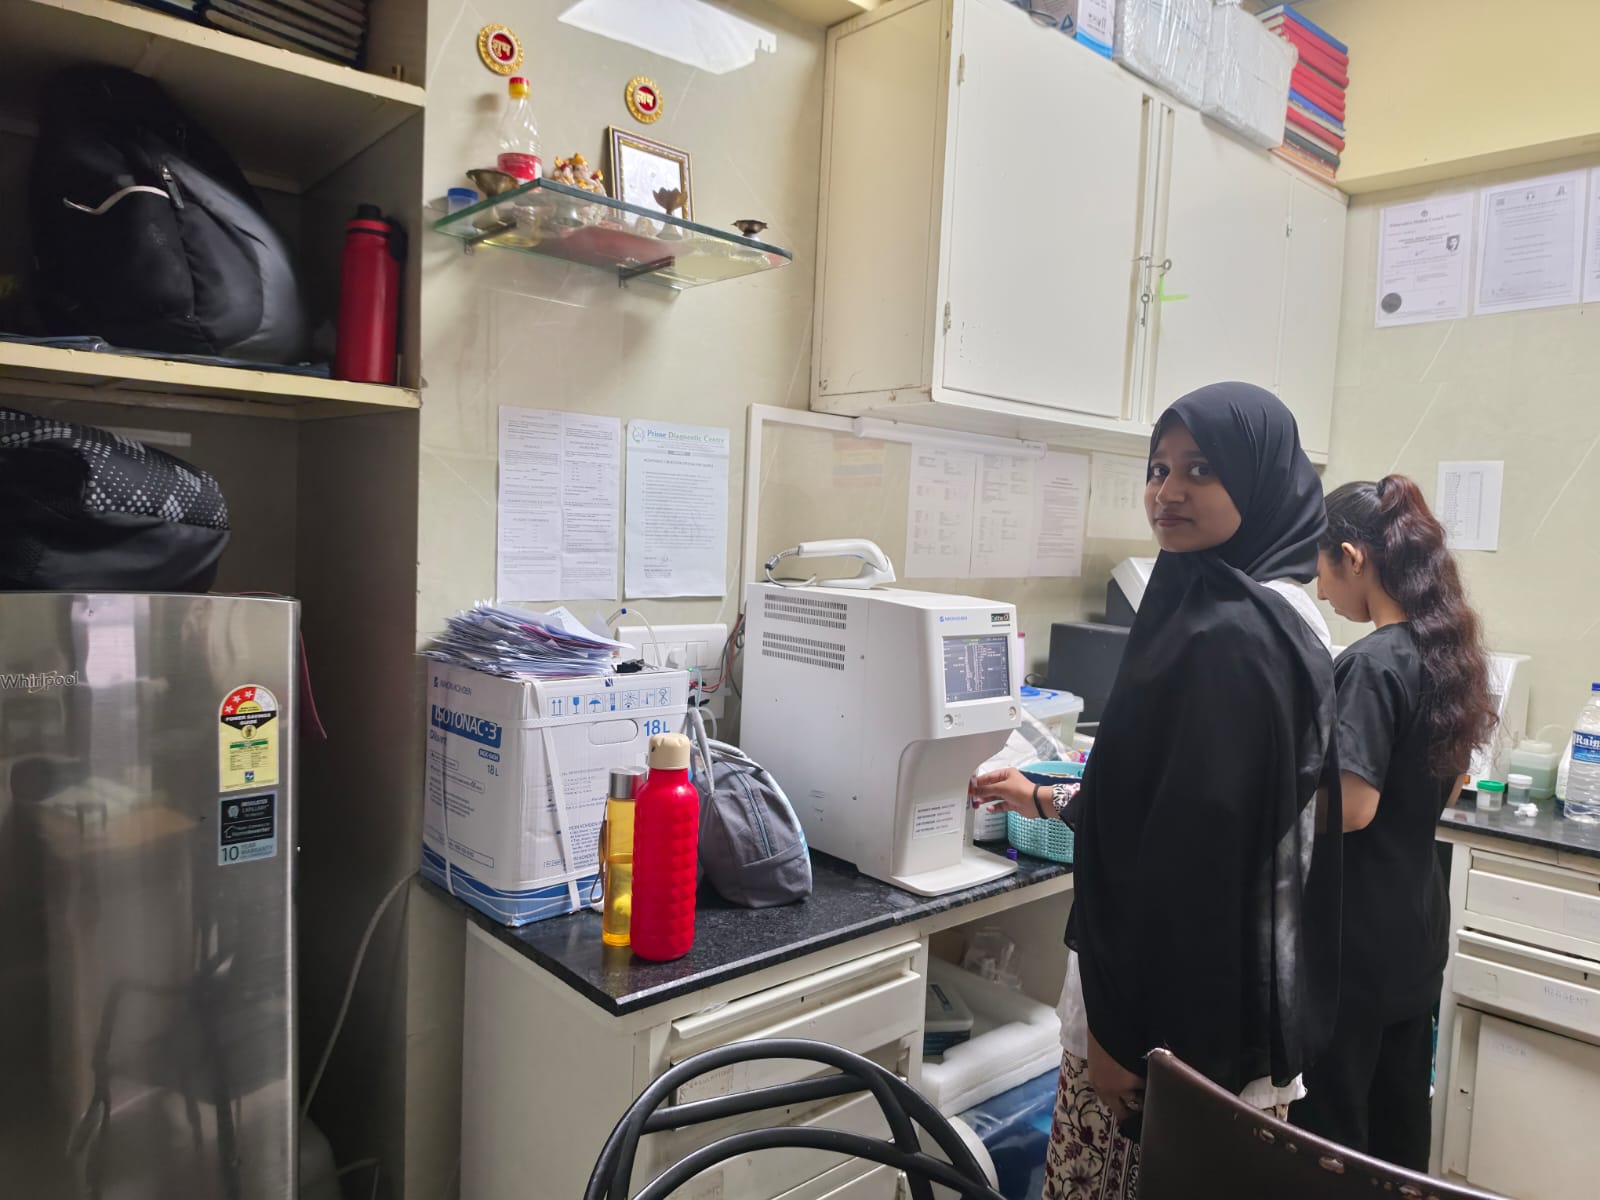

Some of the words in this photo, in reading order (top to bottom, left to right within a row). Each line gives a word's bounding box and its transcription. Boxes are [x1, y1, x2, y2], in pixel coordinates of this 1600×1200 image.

[0, 671, 79, 690] Whirlpool
[643, 719, 661, 737] 18
[663, 720, 671, 733] L
[487, 764, 496, 775] 18
[221, 845, 239, 862] 10
